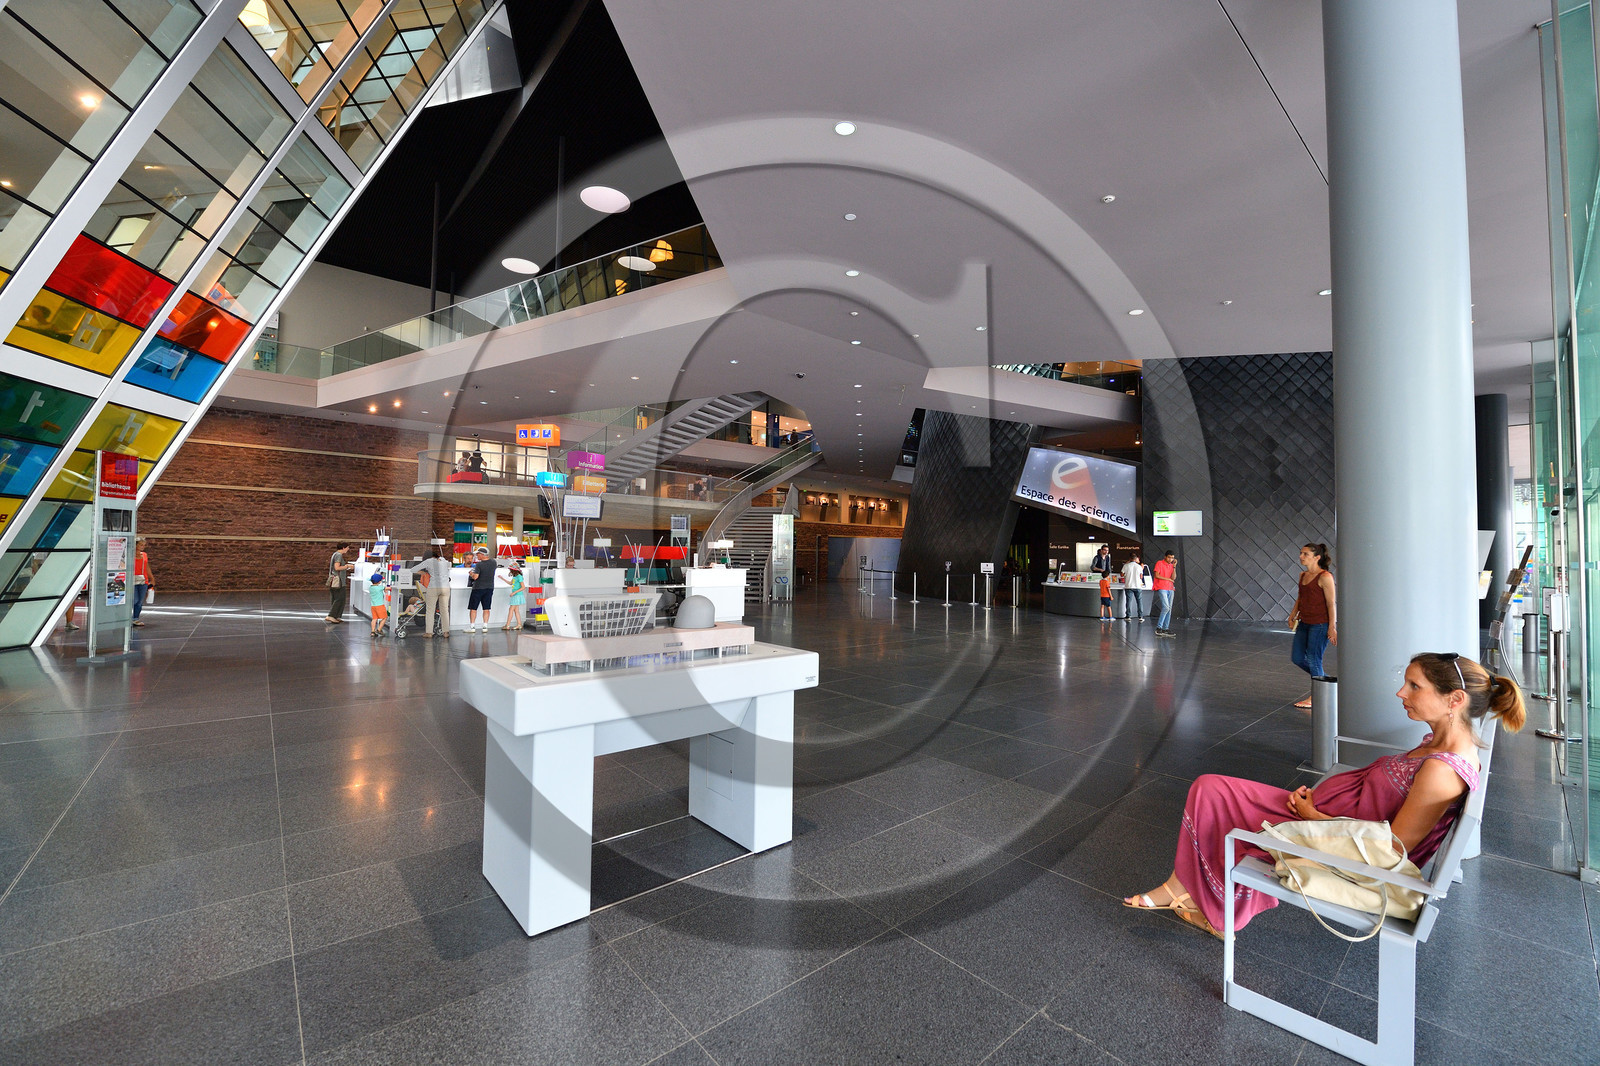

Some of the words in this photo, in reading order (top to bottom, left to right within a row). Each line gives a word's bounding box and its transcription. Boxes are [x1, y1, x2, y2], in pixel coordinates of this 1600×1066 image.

[578, 460, 604, 470] Information
[1020, 484, 1054, 503] Espace
[1058, 496, 1077, 510] des
[1080, 503, 1130, 527] sciences
